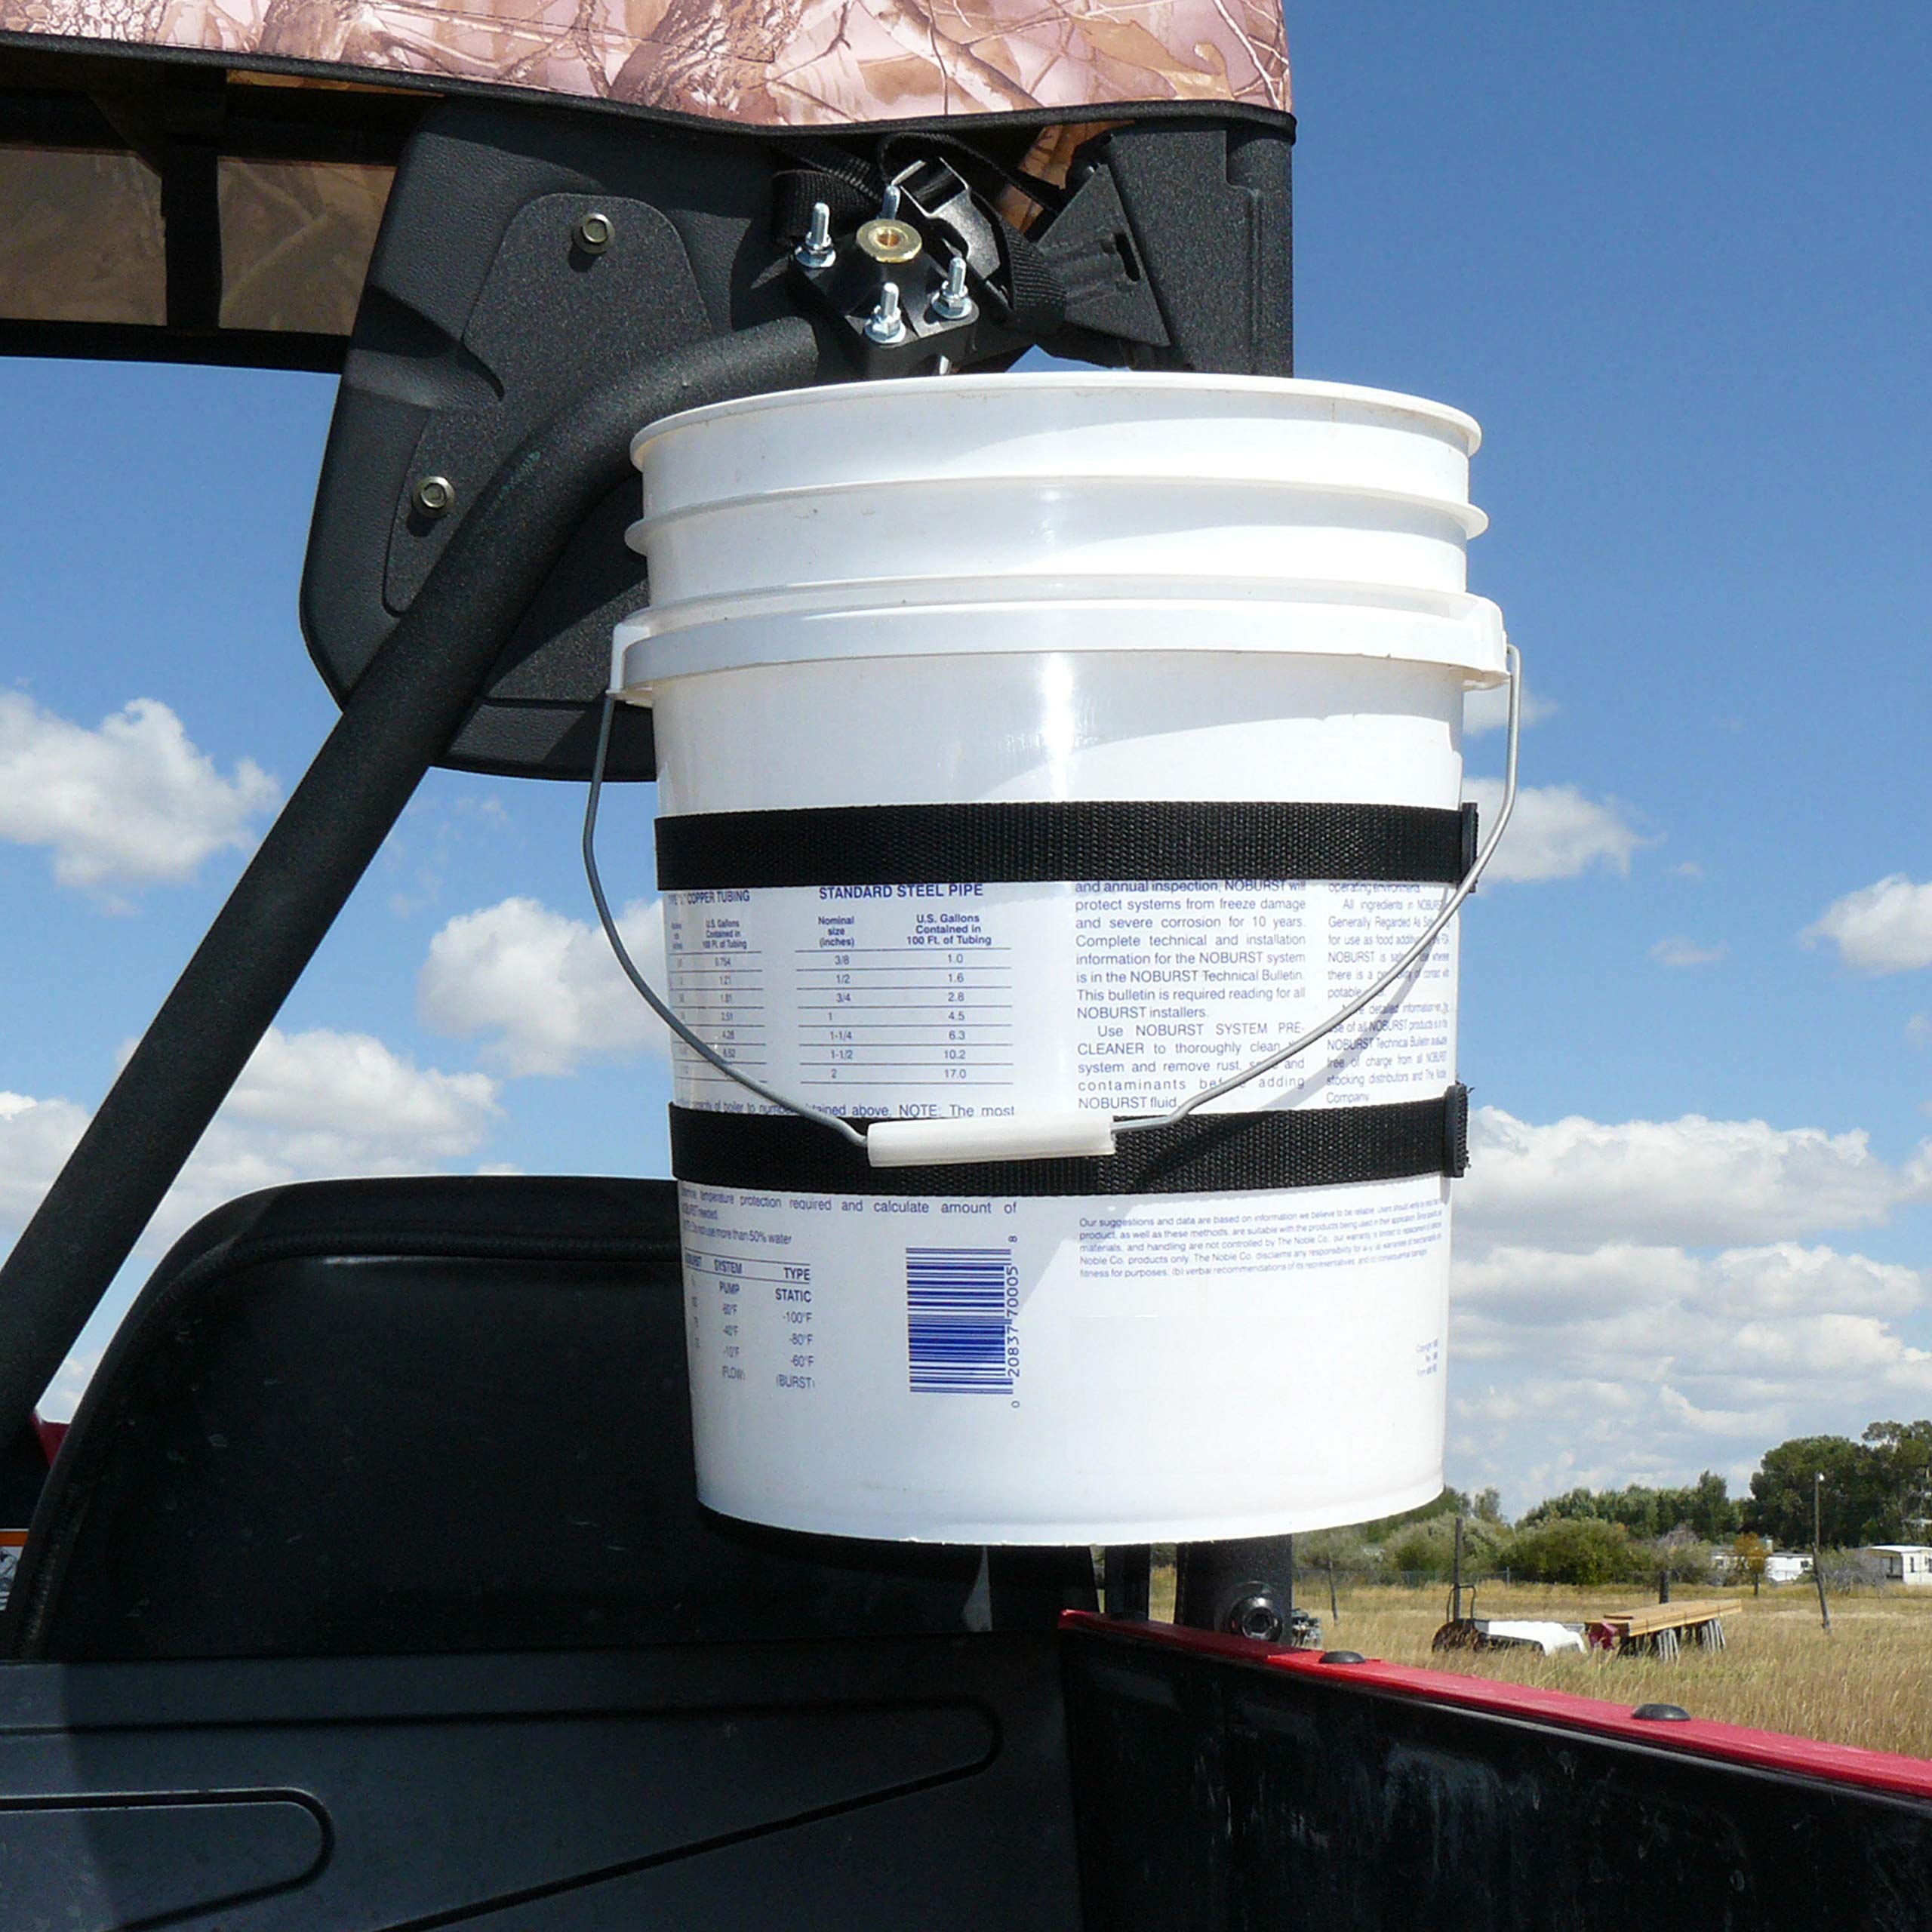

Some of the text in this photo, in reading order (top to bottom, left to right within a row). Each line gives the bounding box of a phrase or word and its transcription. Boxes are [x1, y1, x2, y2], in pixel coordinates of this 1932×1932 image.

[819, 884, 983, 900] STANDARD STEEL PIPE
[1075, 881, 1100, 892] and
[1104, 881, 1148, 892] annual
[1225, 880, 1284, 891] NOBURST
[1289, 881, 1306, 891] will
[717, 891, 749, 903] TUBING
[1075, 898, 1306, 912] protect systems from freeze damage
[818, 916, 854, 925] Nominal
[917, 914, 980, 923] U.S. Gallons
[1076, 916, 1306, 930] and severe corrosion for 10 years.
[915, 925, 968, 934] Contained
[820, 937, 854, 947] (inches)
[907, 935, 992, 946] 100 Ft. of Tubing
[1076, 934, 1306, 949] Complete technical and installation
[835, 954, 963, 964] 3/8 1.0
[1076, 952, 1306, 965] information for the NOBURST system
[1328, 951, 1375, 963] NOBURST
[836, 974, 964, 983] 1/2 1.6
[1077, 971, 1087, 983] is
[1091, 971, 1102, 983] in
[1106, 971, 1126, 983] the
[1130, 971, 1198, 983] NOBURST
[1202, 970, 1258, 981] Technical
[1328, 971, 1352, 980] there
[836, 992, 964, 1002] 3/4 2.8
[1077, 987, 1306, 1002] This bulletin is required reading for all
[829, 1011, 965, 1021] 1 4.5
[1077, 1007, 1146, 1019] NOBURST
[830, 1030, 965, 1040] 1-1/4 6.3
[1097, 1023, 1304, 1037] Use NOBURST SYSTEM PRE-
[1078, 1043, 1144, 1055] CLEANER
[1154, 1043, 1166, 1054] to
[1176, 1041, 1241, 1056] thoroughly
[1251, 1041, 1281, 1052] clean
[1327, 1038, 1373, 1051] NOBURST
[831, 1050, 966, 1059] 1-1/2 10.2
[1078, 1062, 1124, 1074] system
[1132, 1061, 1155, 1072] and
[1163, 1061, 1210, 1072] remove
[1284, 1058, 1304, 1069] and
[831, 1069, 967, 1078] 2 17.0
[1078, 1080, 1186, 1091] contaminants
[1259, 1077, 1305, 1091] adding
[1078, 1097, 1147, 1109] NOBURST
[759, 1104, 795, 1115] numbe
[949, 1103, 974, 1116] The
[982, 1105, 1015, 1115] most
[740, 1195, 1017, 1214] protection required and calculate amount of
[1079, 1218, 1097, 1227] Our
[1100, 1218, 1155, 1229] suggestions
[1157, 1217, 1174, 1226] and
[1177, 1217, 1195, 1225] data
[1214, 1215, 1239, 1224] based
[749, 1230, 768, 1243] 50%
[768, 1234, 792, 1244] water
[1133, 1230, 1151, 1238] well
[1164, 1229, 1187, 1238] these
[1127, 1242, 1144, 1252] and
[1147, 1242, 1186, 1252] handling
[1205, 1241, 1219, 1249] not
[1128, 1255, 1168, 1265] products
[783, 1267, 811, 1280] TYPE
[719, 1281, 812, 1303] PUMP STATIC
